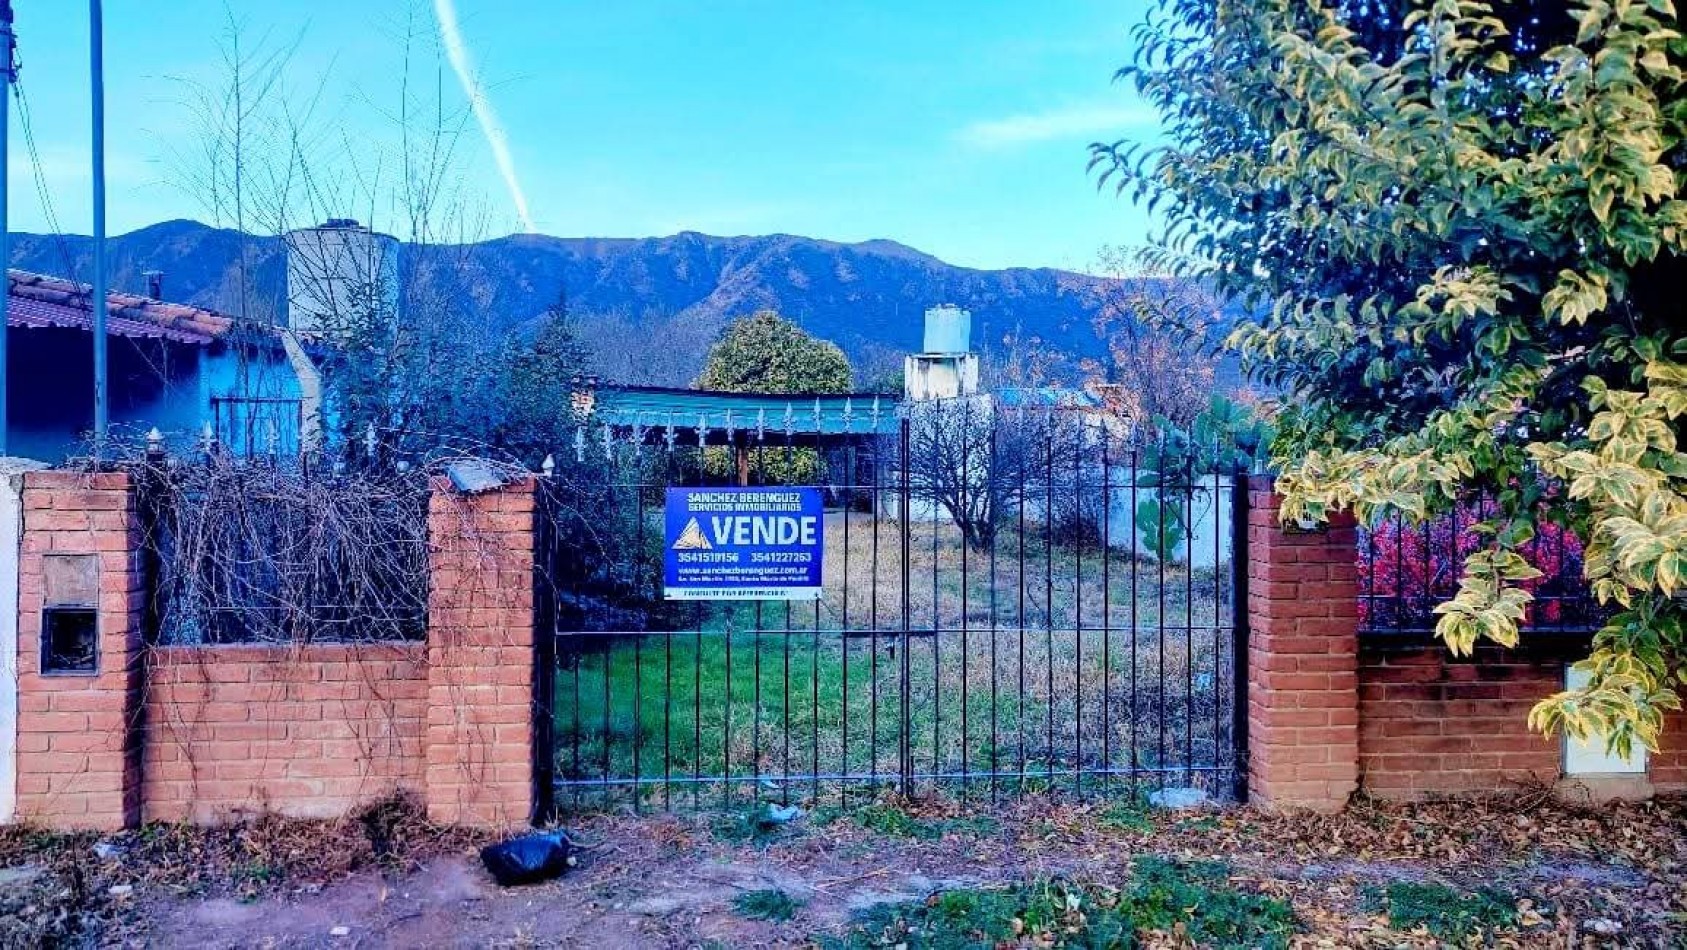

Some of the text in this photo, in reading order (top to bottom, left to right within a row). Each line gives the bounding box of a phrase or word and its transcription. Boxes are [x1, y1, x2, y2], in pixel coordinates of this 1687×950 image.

[688, 492, 800, 503] SANCHEZ BERENGUEZ
[688, 503, 802, 512] SERVICIOS INMOBILIARIOS
[711, 516, 817, 545] VENDE
